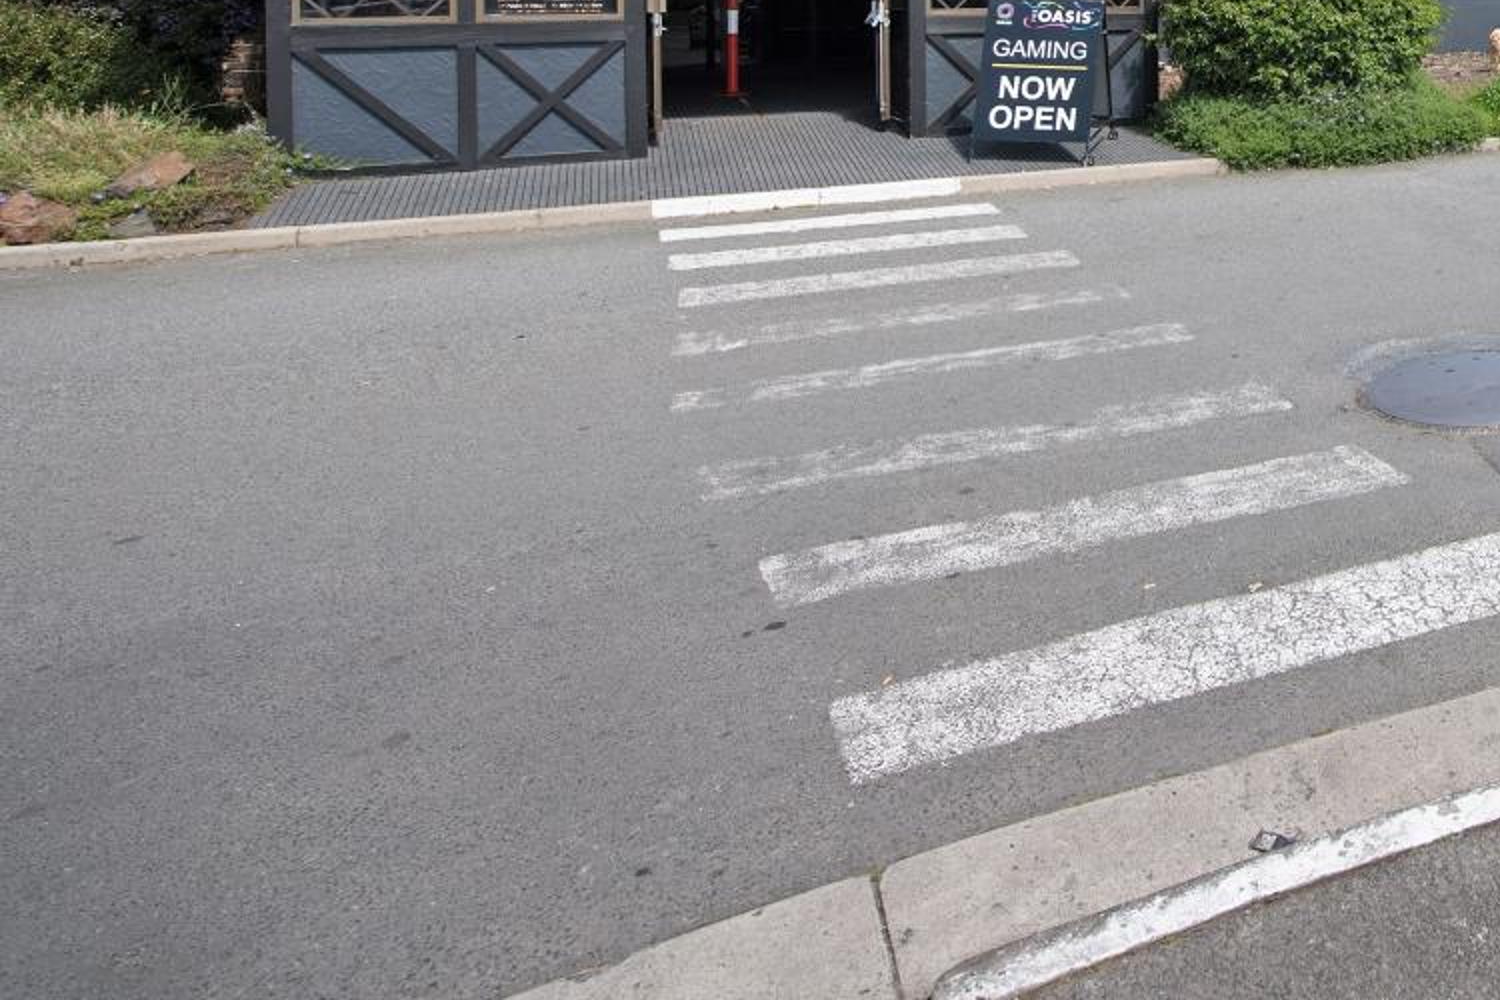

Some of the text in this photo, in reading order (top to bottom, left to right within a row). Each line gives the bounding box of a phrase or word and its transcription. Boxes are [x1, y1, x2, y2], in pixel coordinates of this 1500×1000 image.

[1037, 9, 1092, 25] OASIS
[992, 38, 1087, 60] GAMING
[998, 75, 1076, 101] NOW
[989, 105, 1077, 131] OPEN
